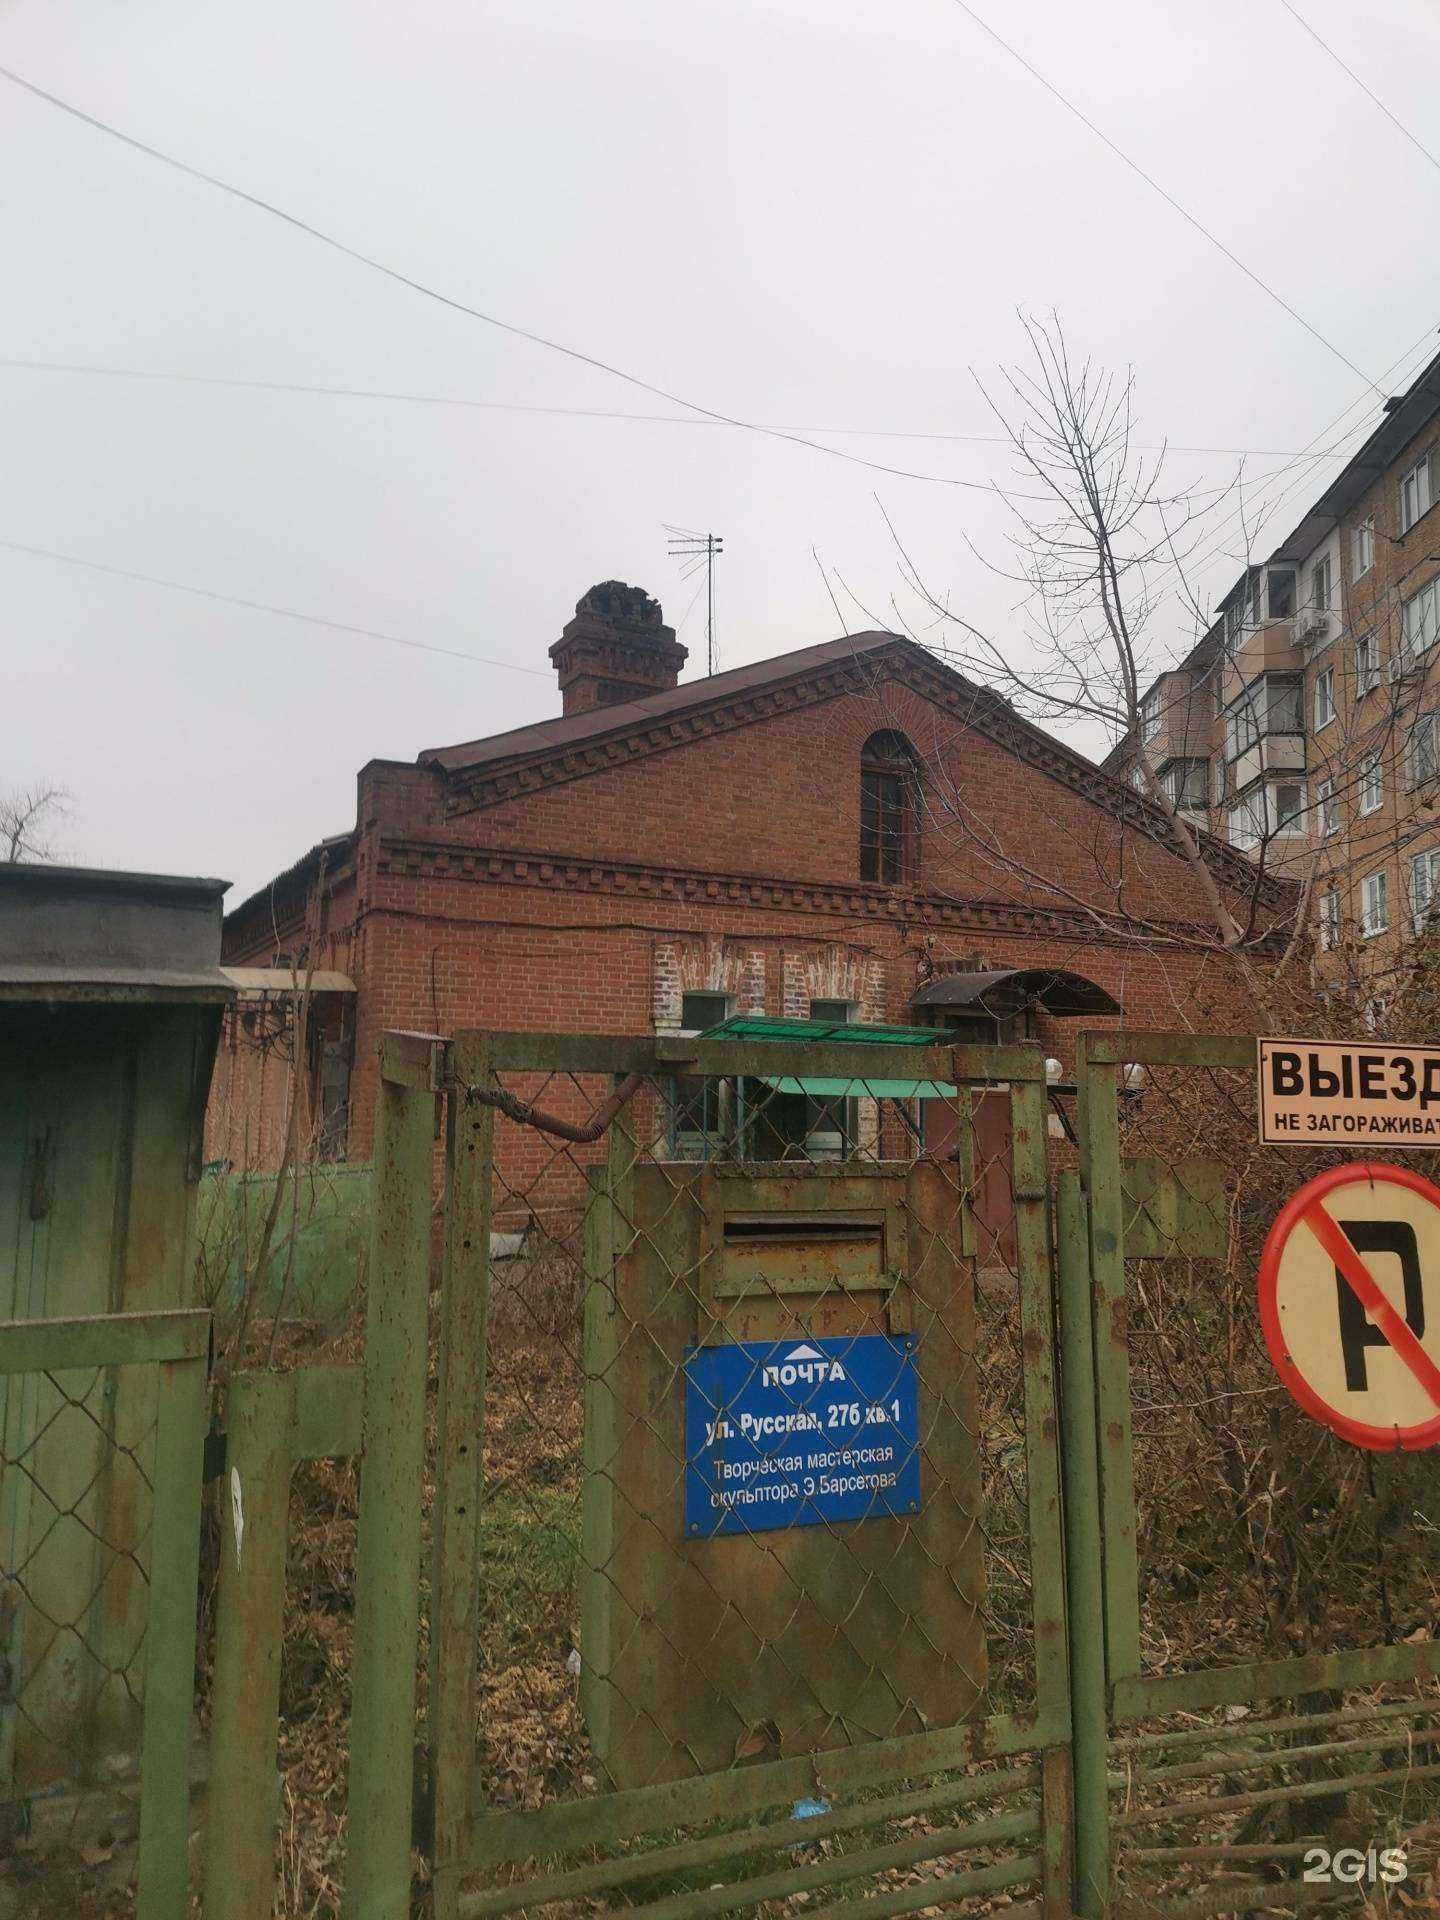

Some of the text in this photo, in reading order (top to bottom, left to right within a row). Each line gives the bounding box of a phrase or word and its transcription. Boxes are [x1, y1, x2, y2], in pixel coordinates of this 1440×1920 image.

[1275, 1113, 1300, 1131] НЕ
[762, 1361, 846, 1388] ПОЧТА
[705, 1421, 735, 1446] ул.
[740, 1412, 823, 1442] Русская,
[713, 1446, 893, 1482] Творческая мастерская
[710, 1482, 799, 1511] скульптора
